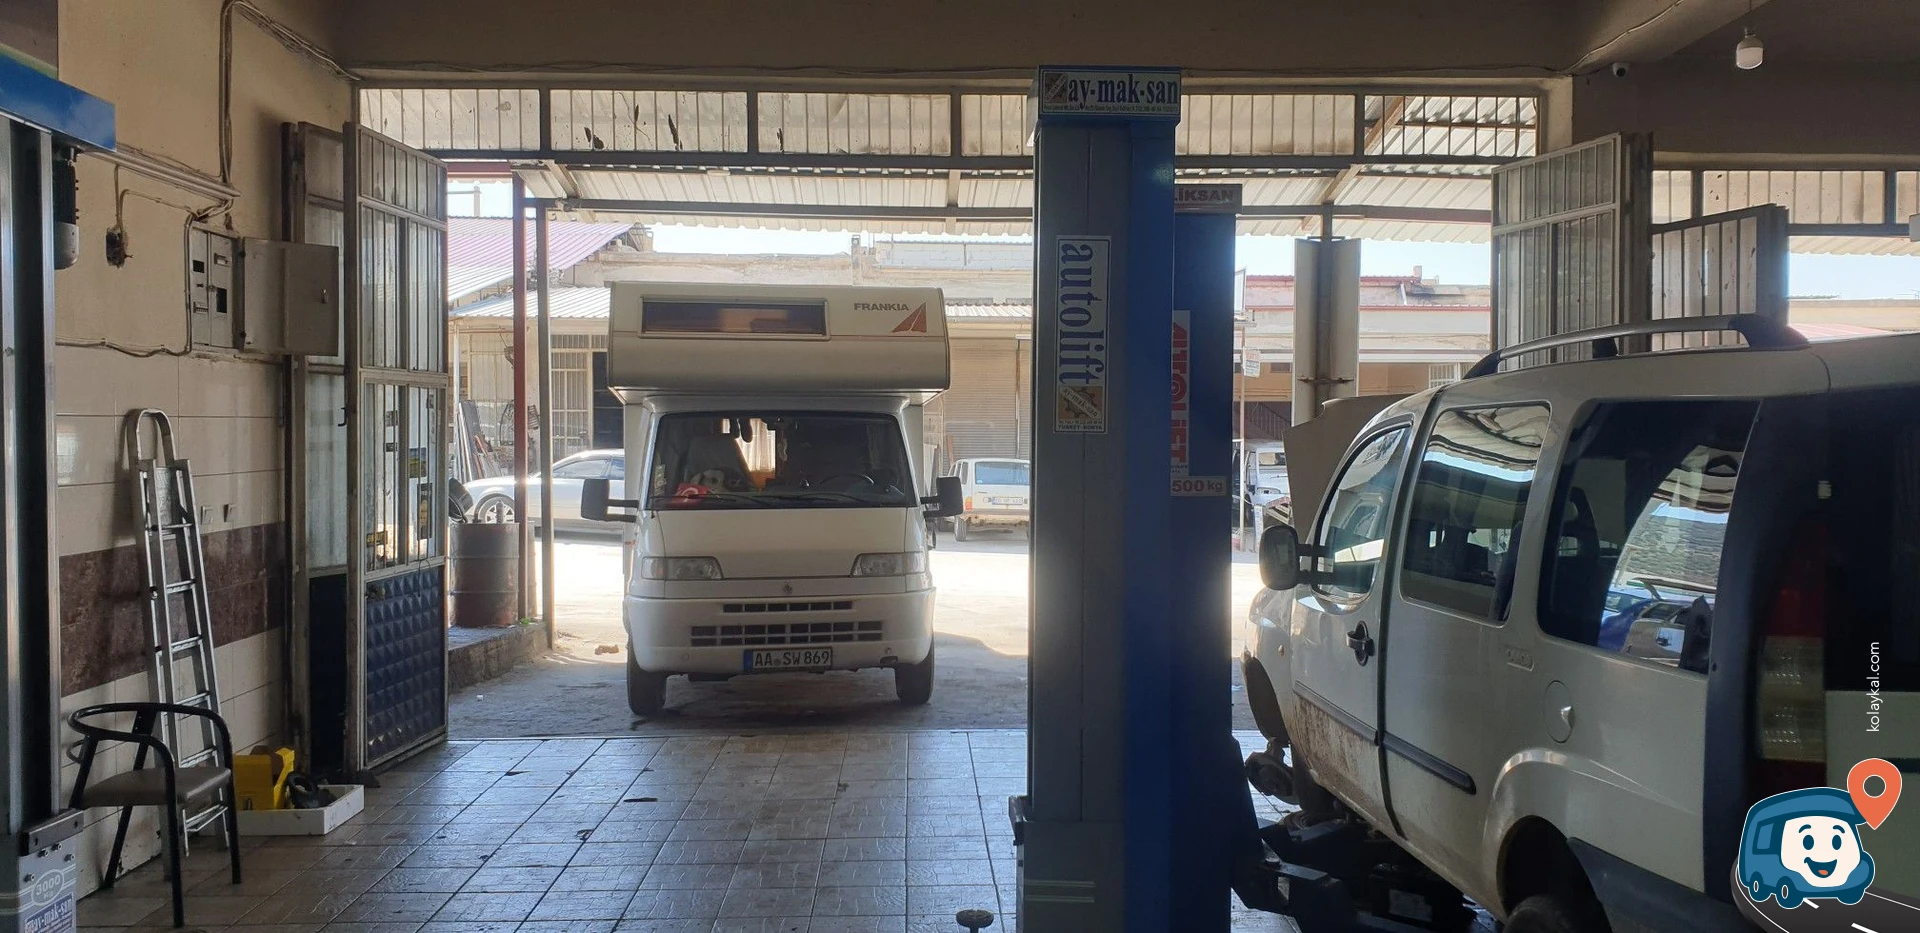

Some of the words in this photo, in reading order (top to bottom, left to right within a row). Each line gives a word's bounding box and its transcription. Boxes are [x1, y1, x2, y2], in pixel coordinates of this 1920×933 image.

[1174, 187, 1233, 202] İKSAN
[854, 302, 909, 311] FRANKIA
[1058, 243, 1105, 384] autolift
[755, 652, 773, 666] AA
[783, 651, 800, 665] SW
[804, 650, 830, 664] 869
[35, 874, 61, 895] 3000
